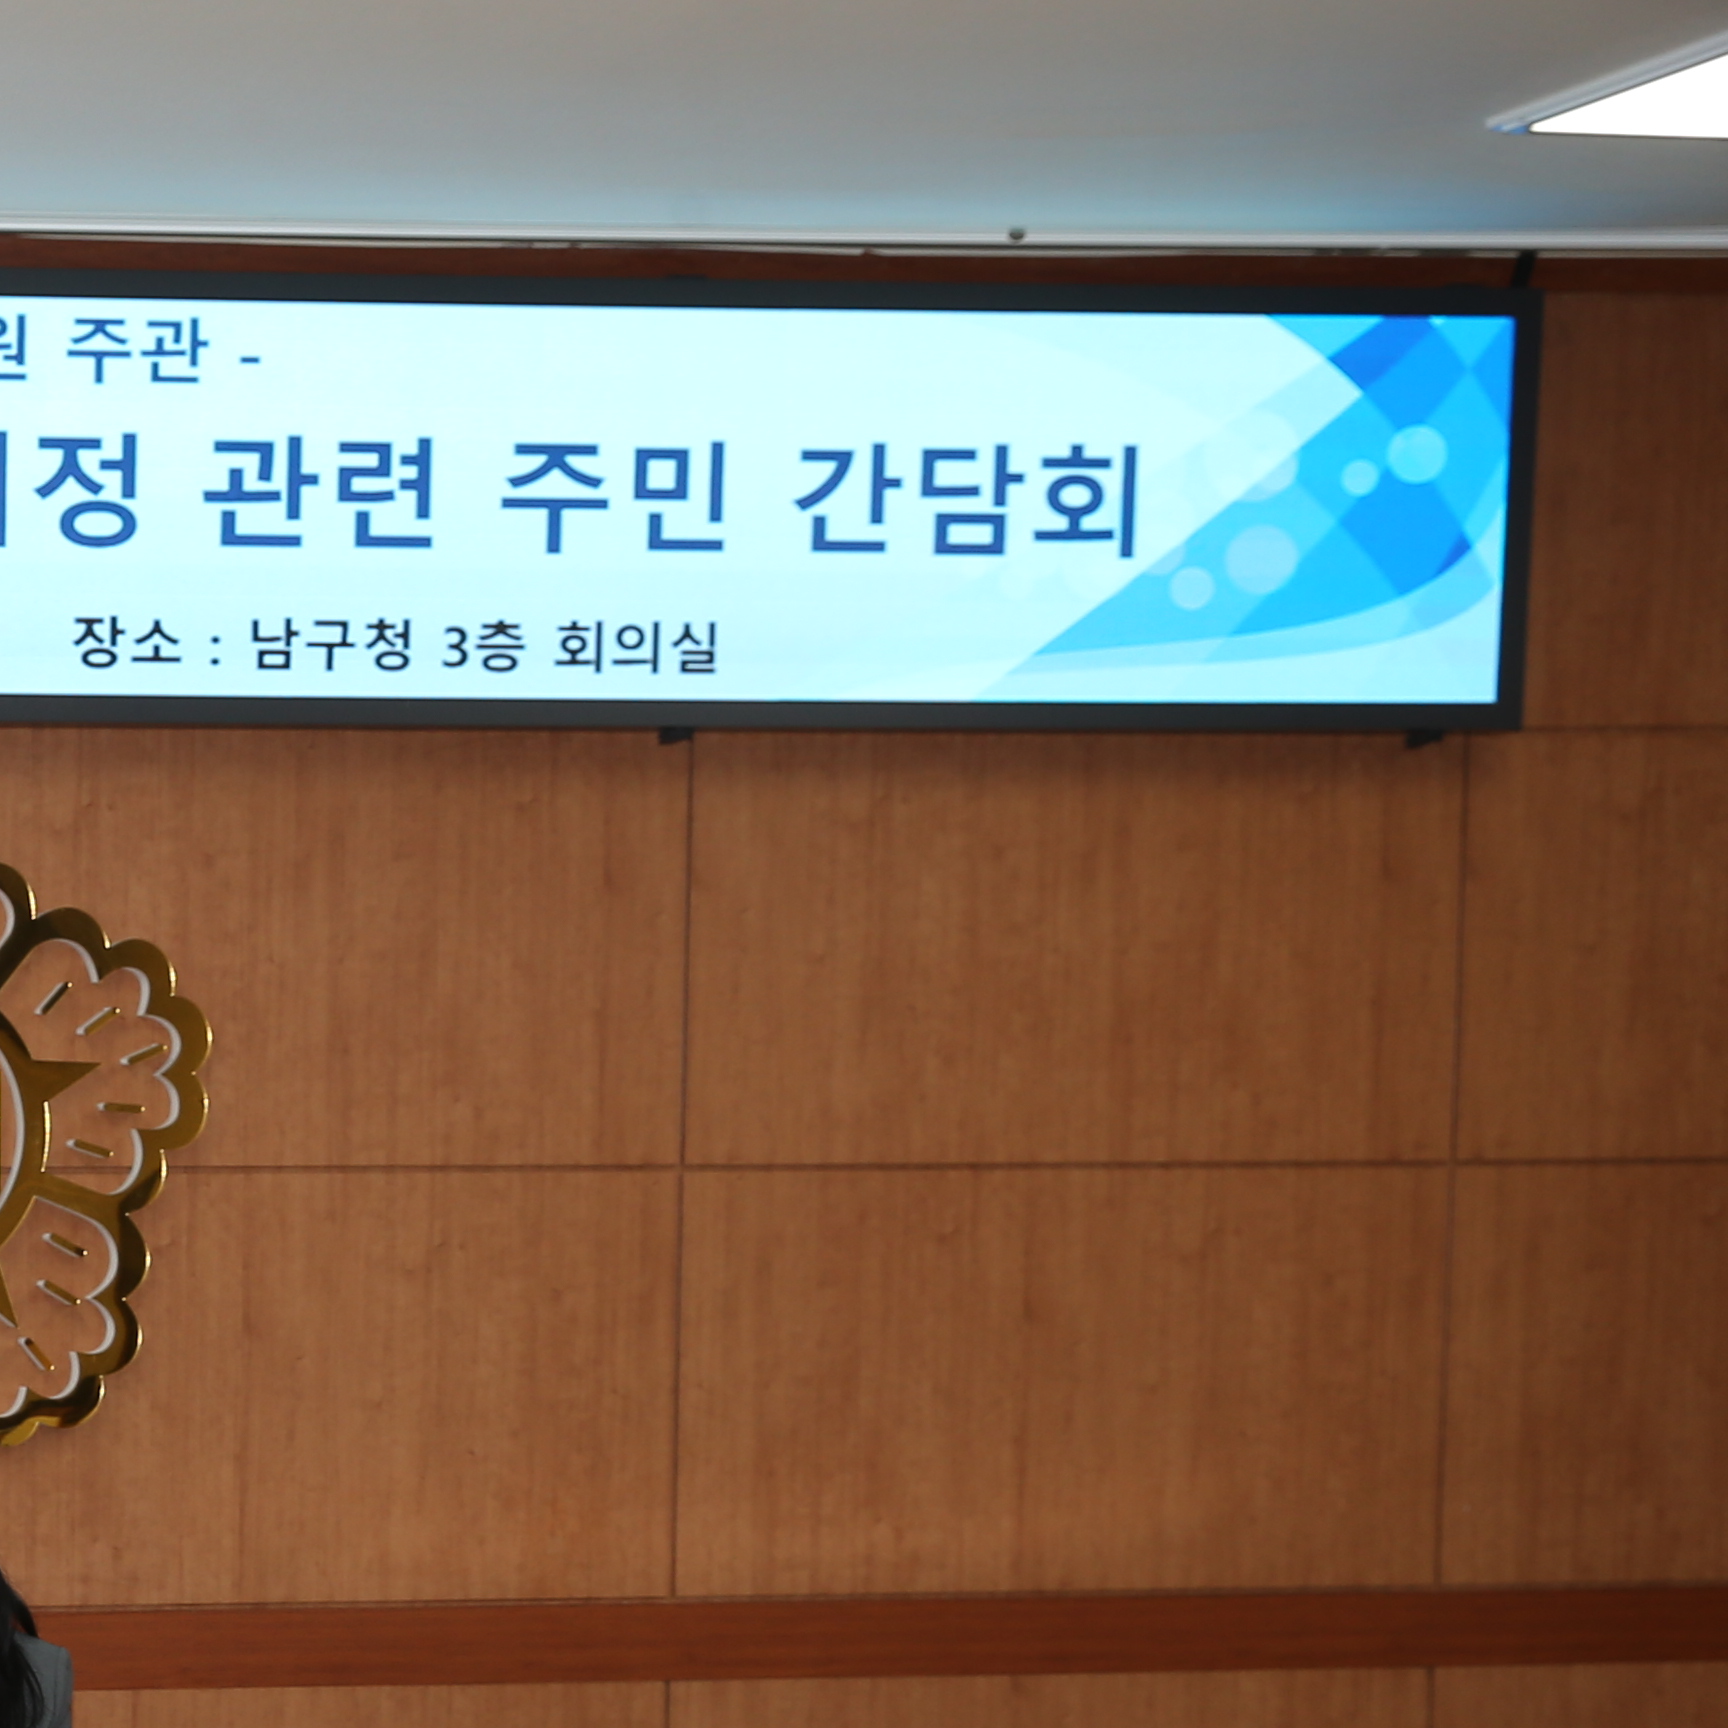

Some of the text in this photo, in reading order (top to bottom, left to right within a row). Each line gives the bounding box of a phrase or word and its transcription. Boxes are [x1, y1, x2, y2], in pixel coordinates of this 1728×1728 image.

[66, 316, 212, 387] 주관
[202, 434, 435, 552] 관련
[500, 440, 728, 557] 주민
[794, 442, 1140, 562] 간담회
[73, 615, 184, 672] 장소
[251, 617, 413, 674] 남구청
[442, 619, 528, 676] 3층
[554, 620, 719, 677] 회의실
